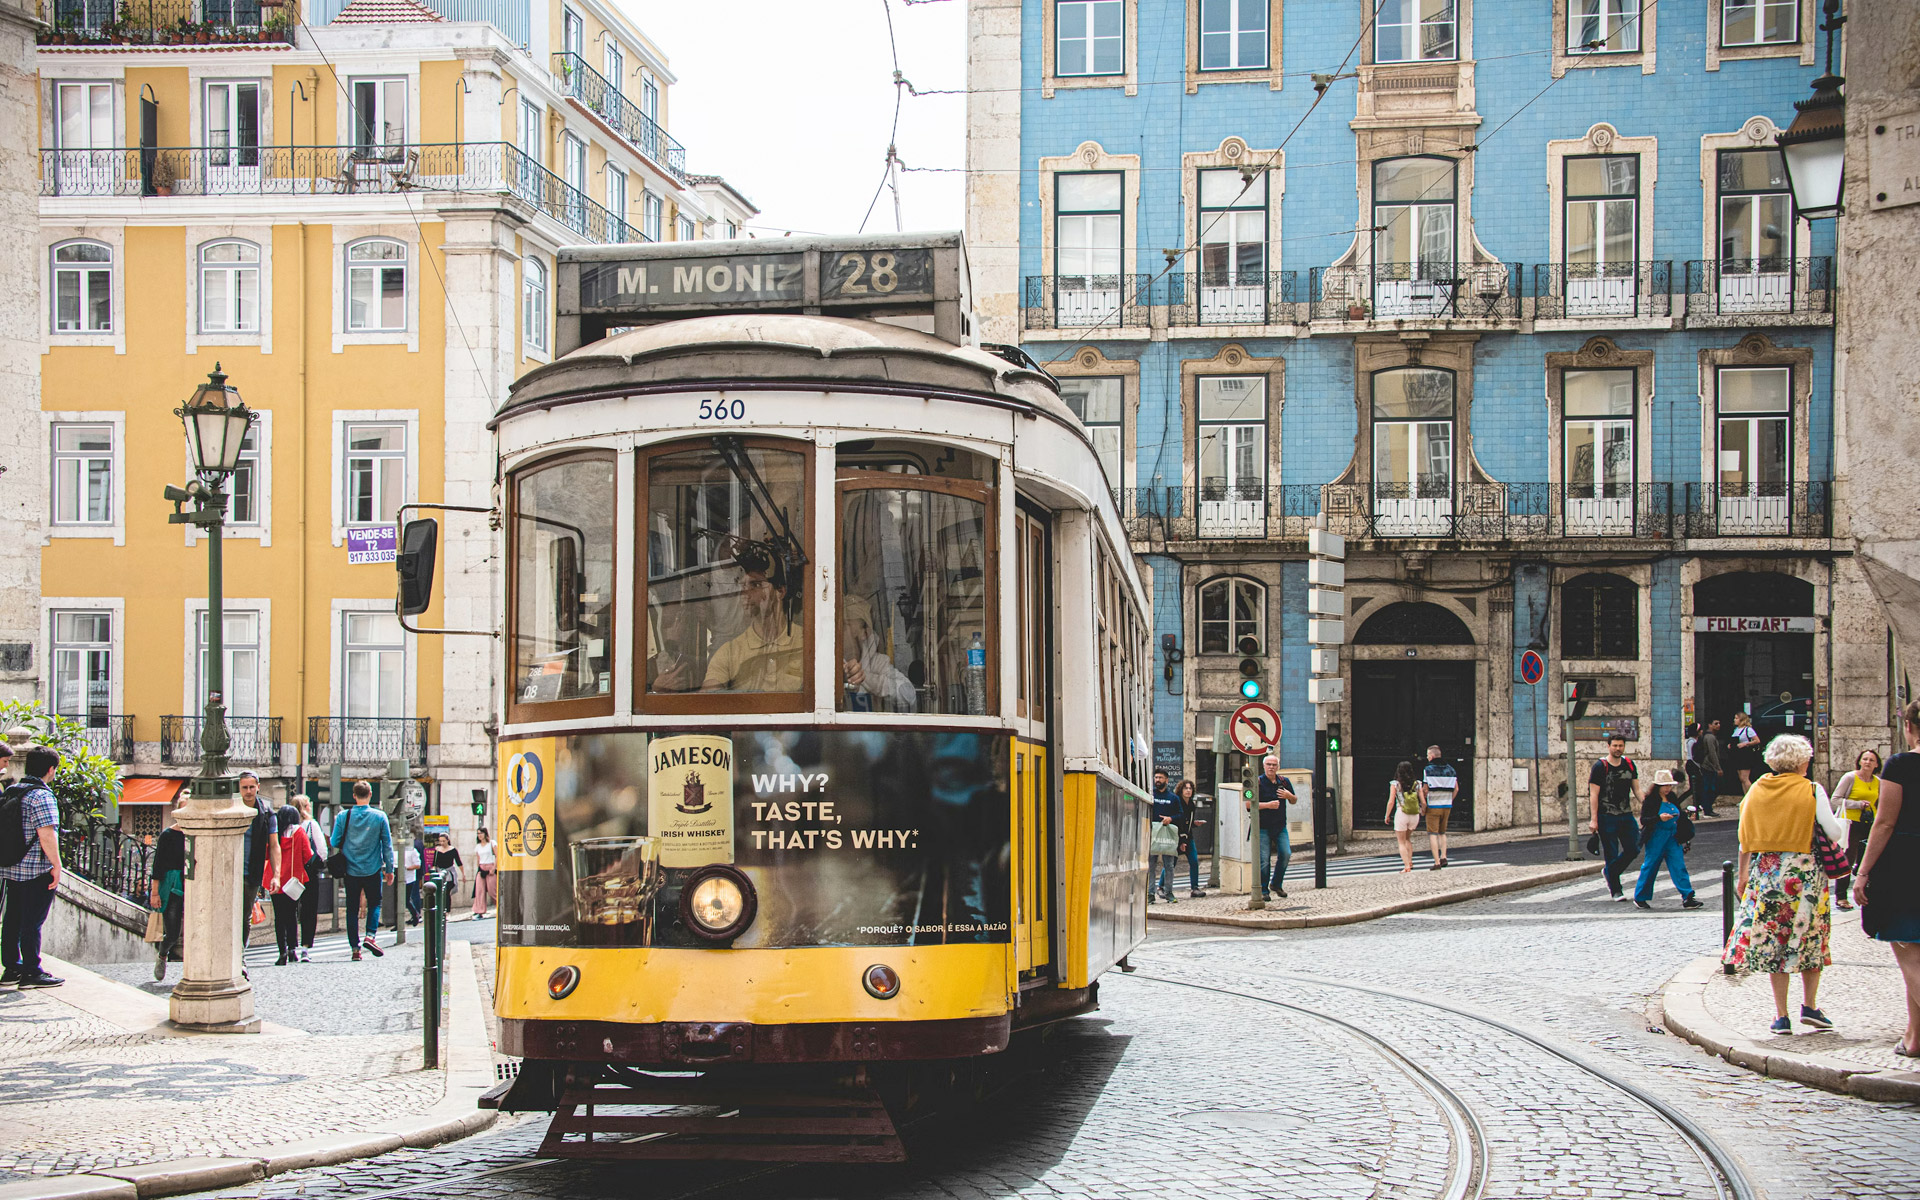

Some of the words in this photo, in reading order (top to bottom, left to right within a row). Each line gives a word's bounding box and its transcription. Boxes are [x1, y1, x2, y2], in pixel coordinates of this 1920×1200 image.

[617, 267, 658, 294] M.
[673, 263, 802, 293] MONIZ
[839, 252, 898, 294] 28
[698, 399, 745, 420] 560
[349, 528, 394, 540] VENDE-SE
[366, 540, 378, 550] T2
[350, 552, 363, 562] 917
[365, 552, 379, 562] 333
[381, 551, 395, 560] 035
[1707, 618, 1747, 631] FOLK
[1761, 618, 1790, 631] ART
[523, 685, 538, 698] 08
[654, 746, 731, 774] JAMESON
[751, 773, 829, 793] WHY?
[751, 802, 842, 824] TASTE,
[661, 830, 684, 838] IRISH
[687, 829, 726, 838] WHISKEY
[751, 829, 843, 850] THAT'S
[905, 925, 913, 933] O
[948, 922, 954, 932] É
[955, 924, 975, 932] ESSA
[976, 923, 982, 932] A
[983, 921, 1008, 931] RAZÃO
